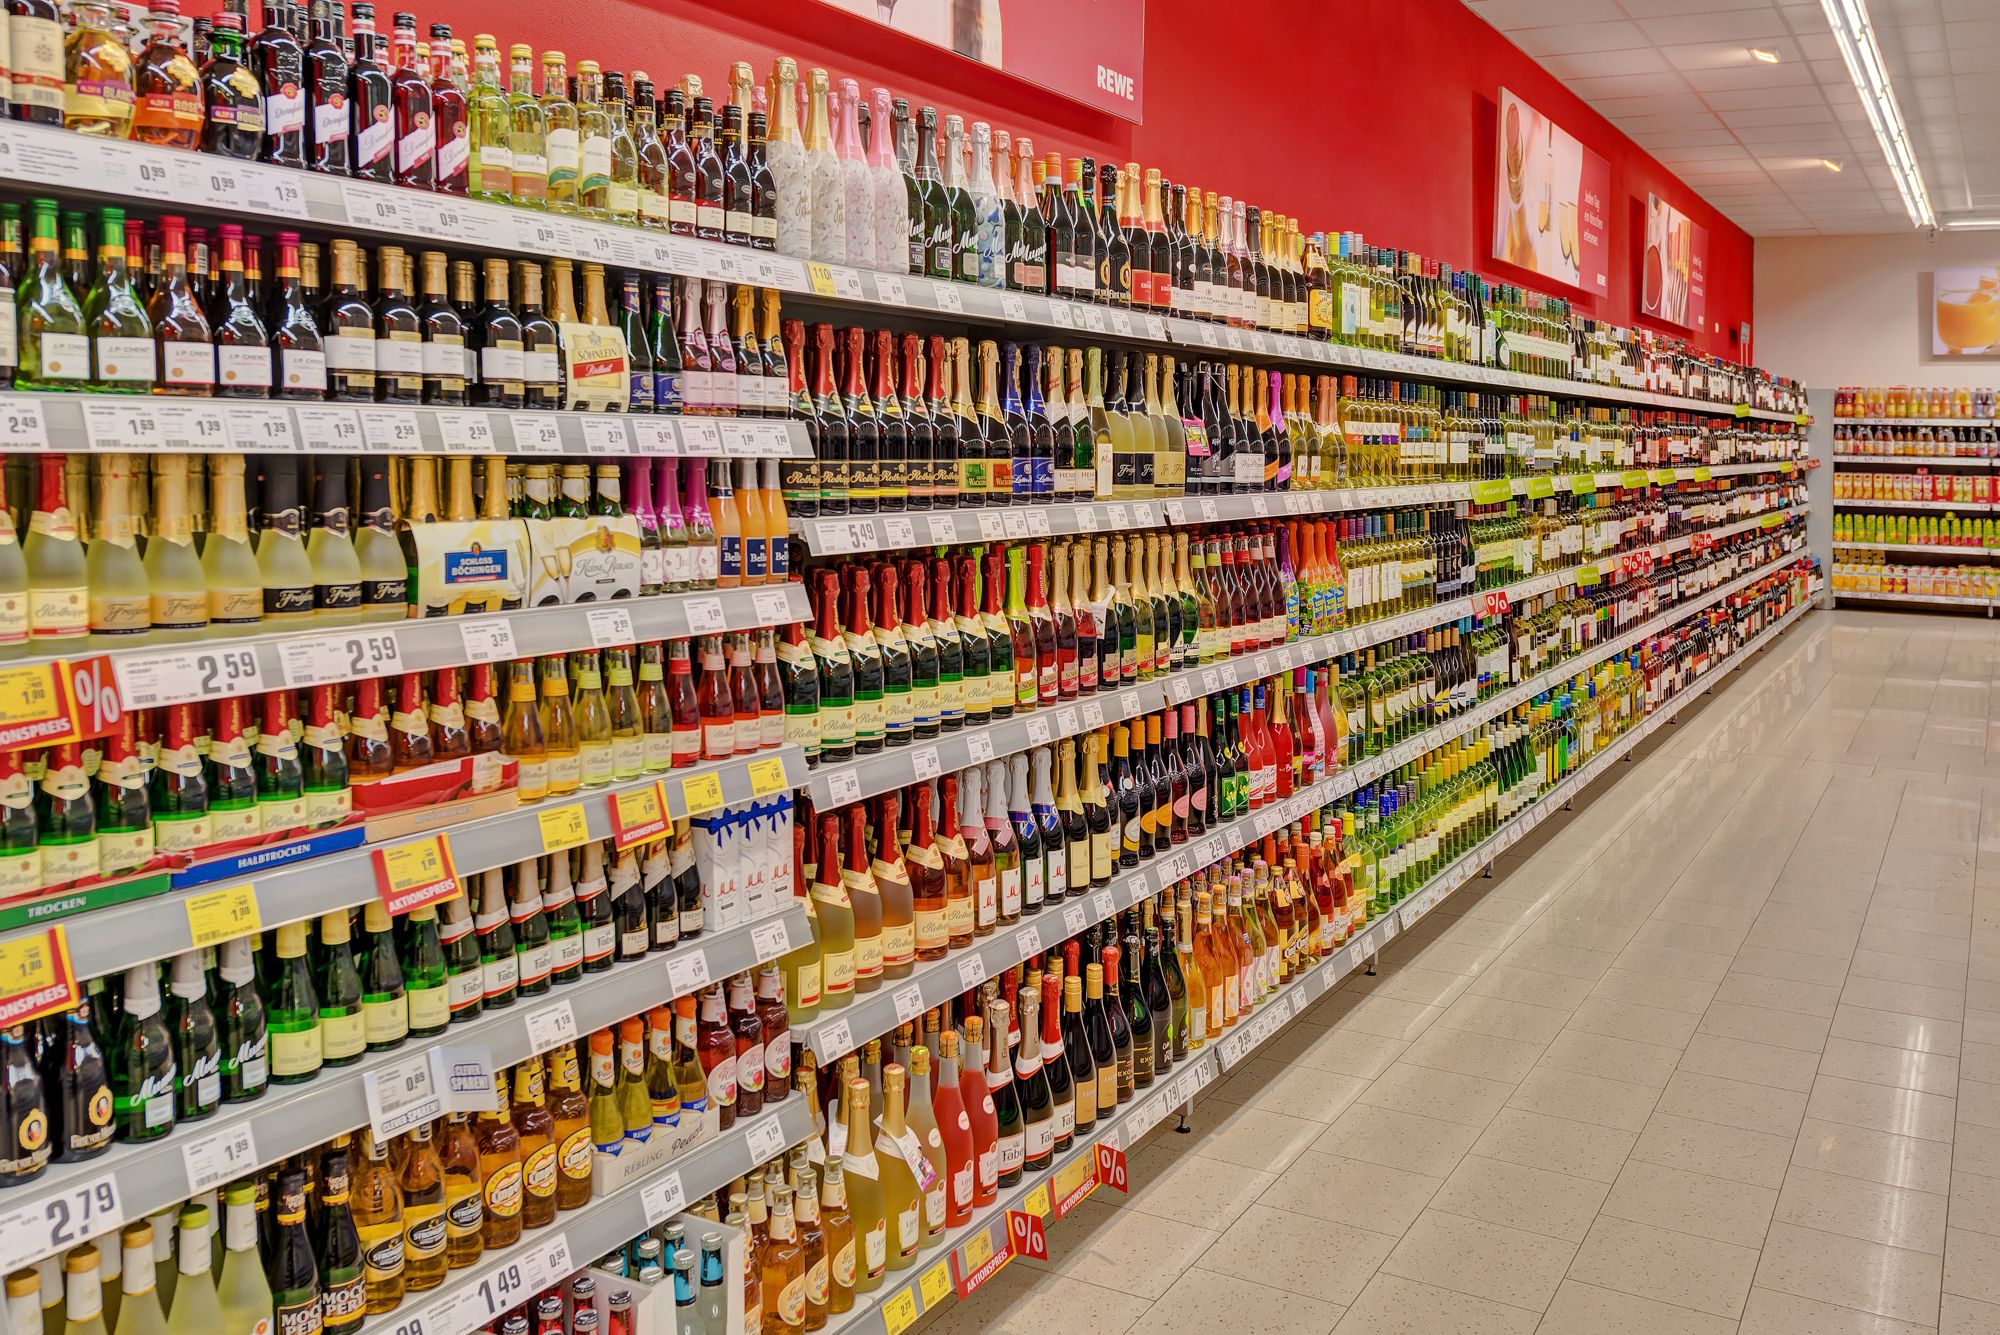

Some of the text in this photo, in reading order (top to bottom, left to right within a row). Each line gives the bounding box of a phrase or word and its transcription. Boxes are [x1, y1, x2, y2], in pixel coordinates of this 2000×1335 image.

[1097, 65, 1134, 100] REWE
[140, 165, 165, 182] 0.99
[211, 176, 235, 192] 0.99
[274, 181, 298, 202] 1.29
[8, 416, 38, 434] 2.49
[128, 419, 154, 435] 1.69
[196, 420, 220, 436] 1.39
[264, 422, 286, 437] 1.39
[334, 424, 355, 438] 1.39
[396, 424, 414, 439] 2.59
[468, 426, 487, 440] 2.59
[850, 523, 874, 548] 5.49
[452, 564, 502, 576] BÖCHINGEN
[460, 557, 493, 566] SCHLOSS
[346, 636, 398, 674] 2.59
[197, 652, 256, 694] 2.59
[75, 660, 120, 733] %
[238, 844, 311, 868] HALBTROCKEN
[28, 896, 86, 918] TROCKEN
[388, 878, 456, 913] AKTIONSPREIS
[1194, 1061, 1209, 1085] 1.79
[1162, 1085, 1178, 1110] 1.79
[224, 1138, 248, 1161] 1.99
[624, 1150, 664, 1177] REBLING
[1101, 1149, 1125, 1185] %
[1060, 1176, 1095, 1216] AKTIONSPREIS
[46, 1182, 115, 1246] 2.79
[1015, 1215, 1043, 1254] %
[549, 1248, 565, 1267] 0.99
[966, 1247, 1008, 1293] AKTIONSPREIS
[477, 1264, 520, 1316] 1.49
